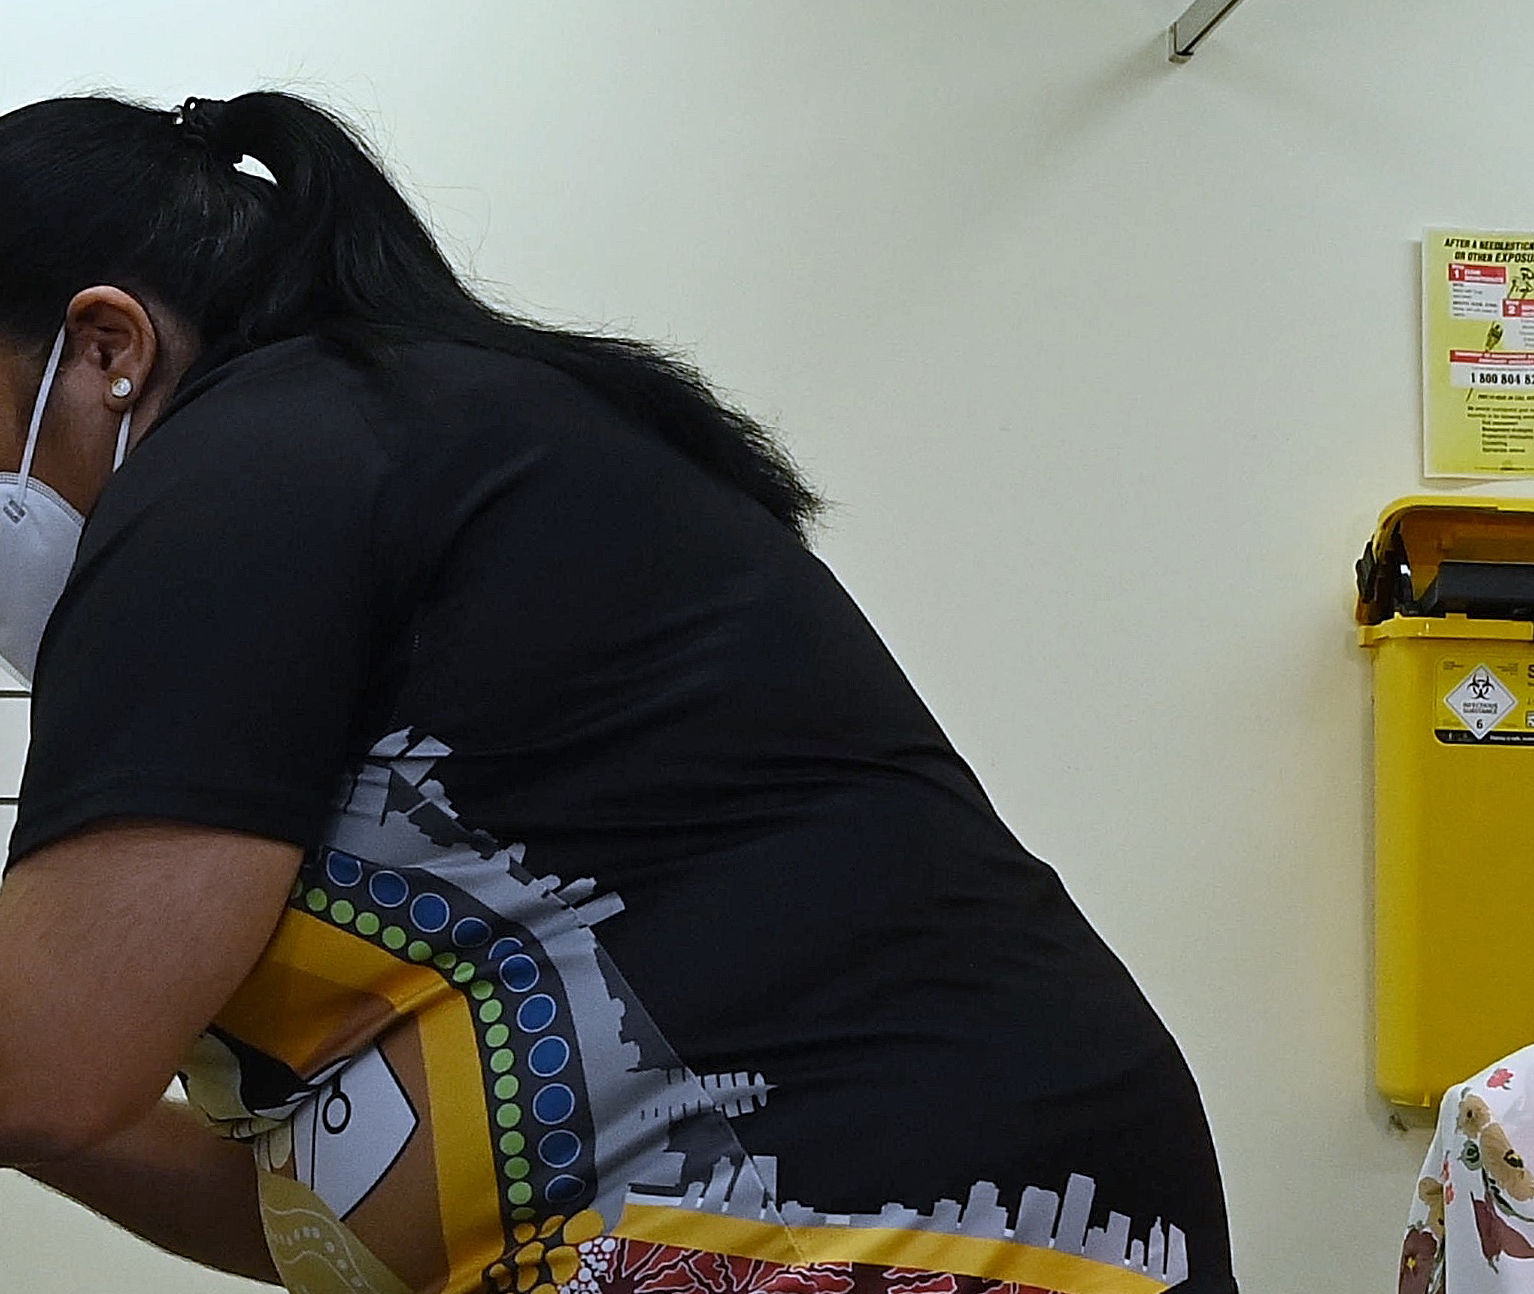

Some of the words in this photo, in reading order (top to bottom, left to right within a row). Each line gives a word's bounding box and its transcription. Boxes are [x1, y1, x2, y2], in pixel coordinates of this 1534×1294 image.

[1445, 239, 1470, 248] AFTER
[1471, 240, 1478, 249] A
[1479, 240, 1534, 250] NEEDLESTICK
[1454, 252, 1466, 260] OR
[1467, 252, 1493, 261] OTHER
[1453, 269, 1460, 279] 1
[1508, 305, 1516, 314] 2
[1471, 372, 1476, 383] 1
[1479, 373, 1498, 384] 800
[1501, 373, 1521, 385] 804
[1476, 719, 1483, 730] 6
